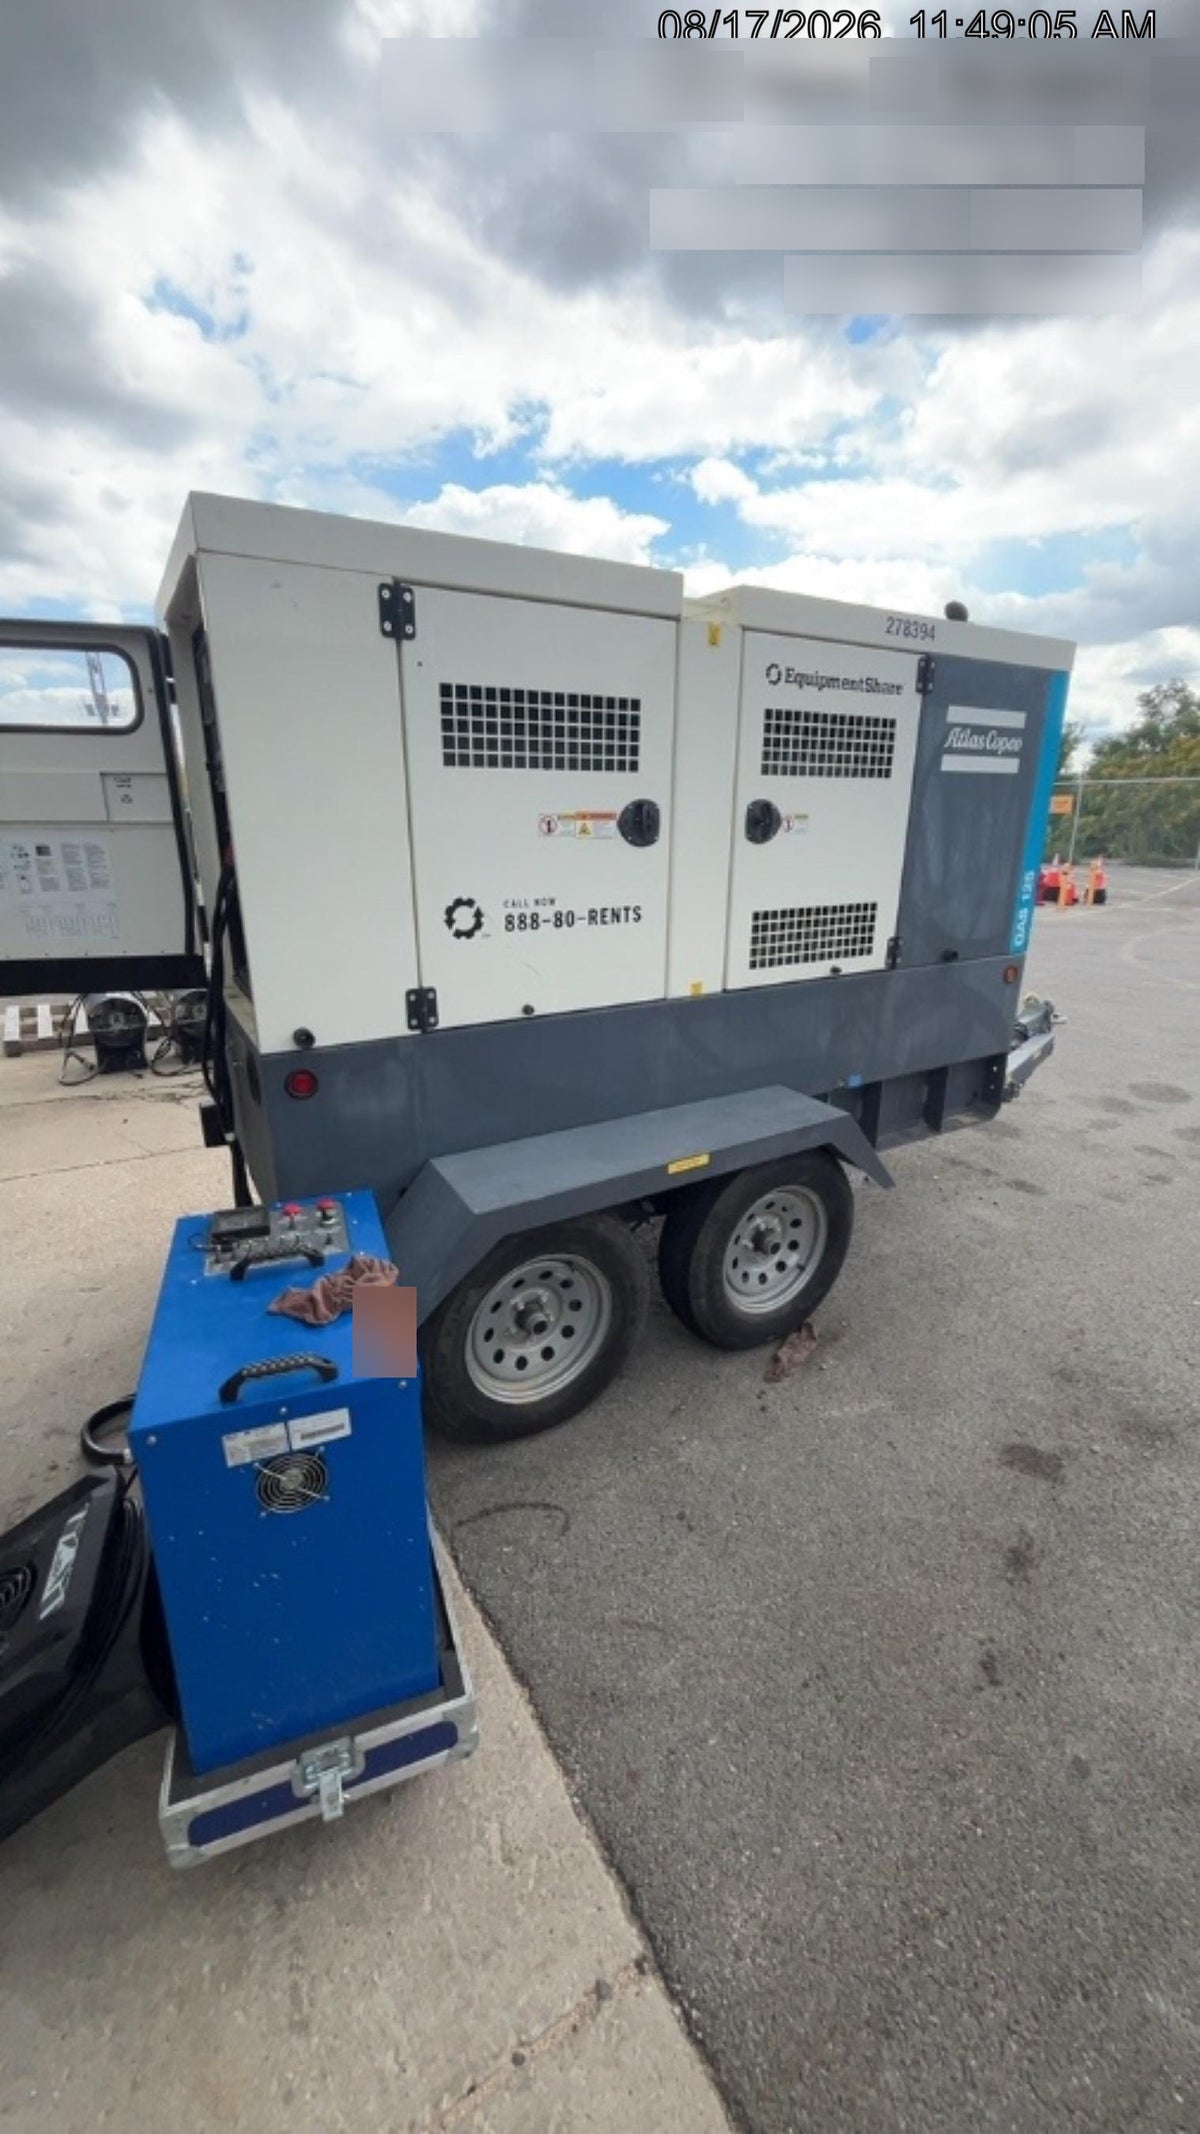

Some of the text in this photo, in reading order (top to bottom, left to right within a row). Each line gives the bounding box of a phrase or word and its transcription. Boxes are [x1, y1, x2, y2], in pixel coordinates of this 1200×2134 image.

[886, 616, 936, 641] 278394
[784, 666, 903, 695] EquipmentShare
[504, 897, 556, 908] CALL NOW
[504, 905, 642, 932] 888-80-RENTS
